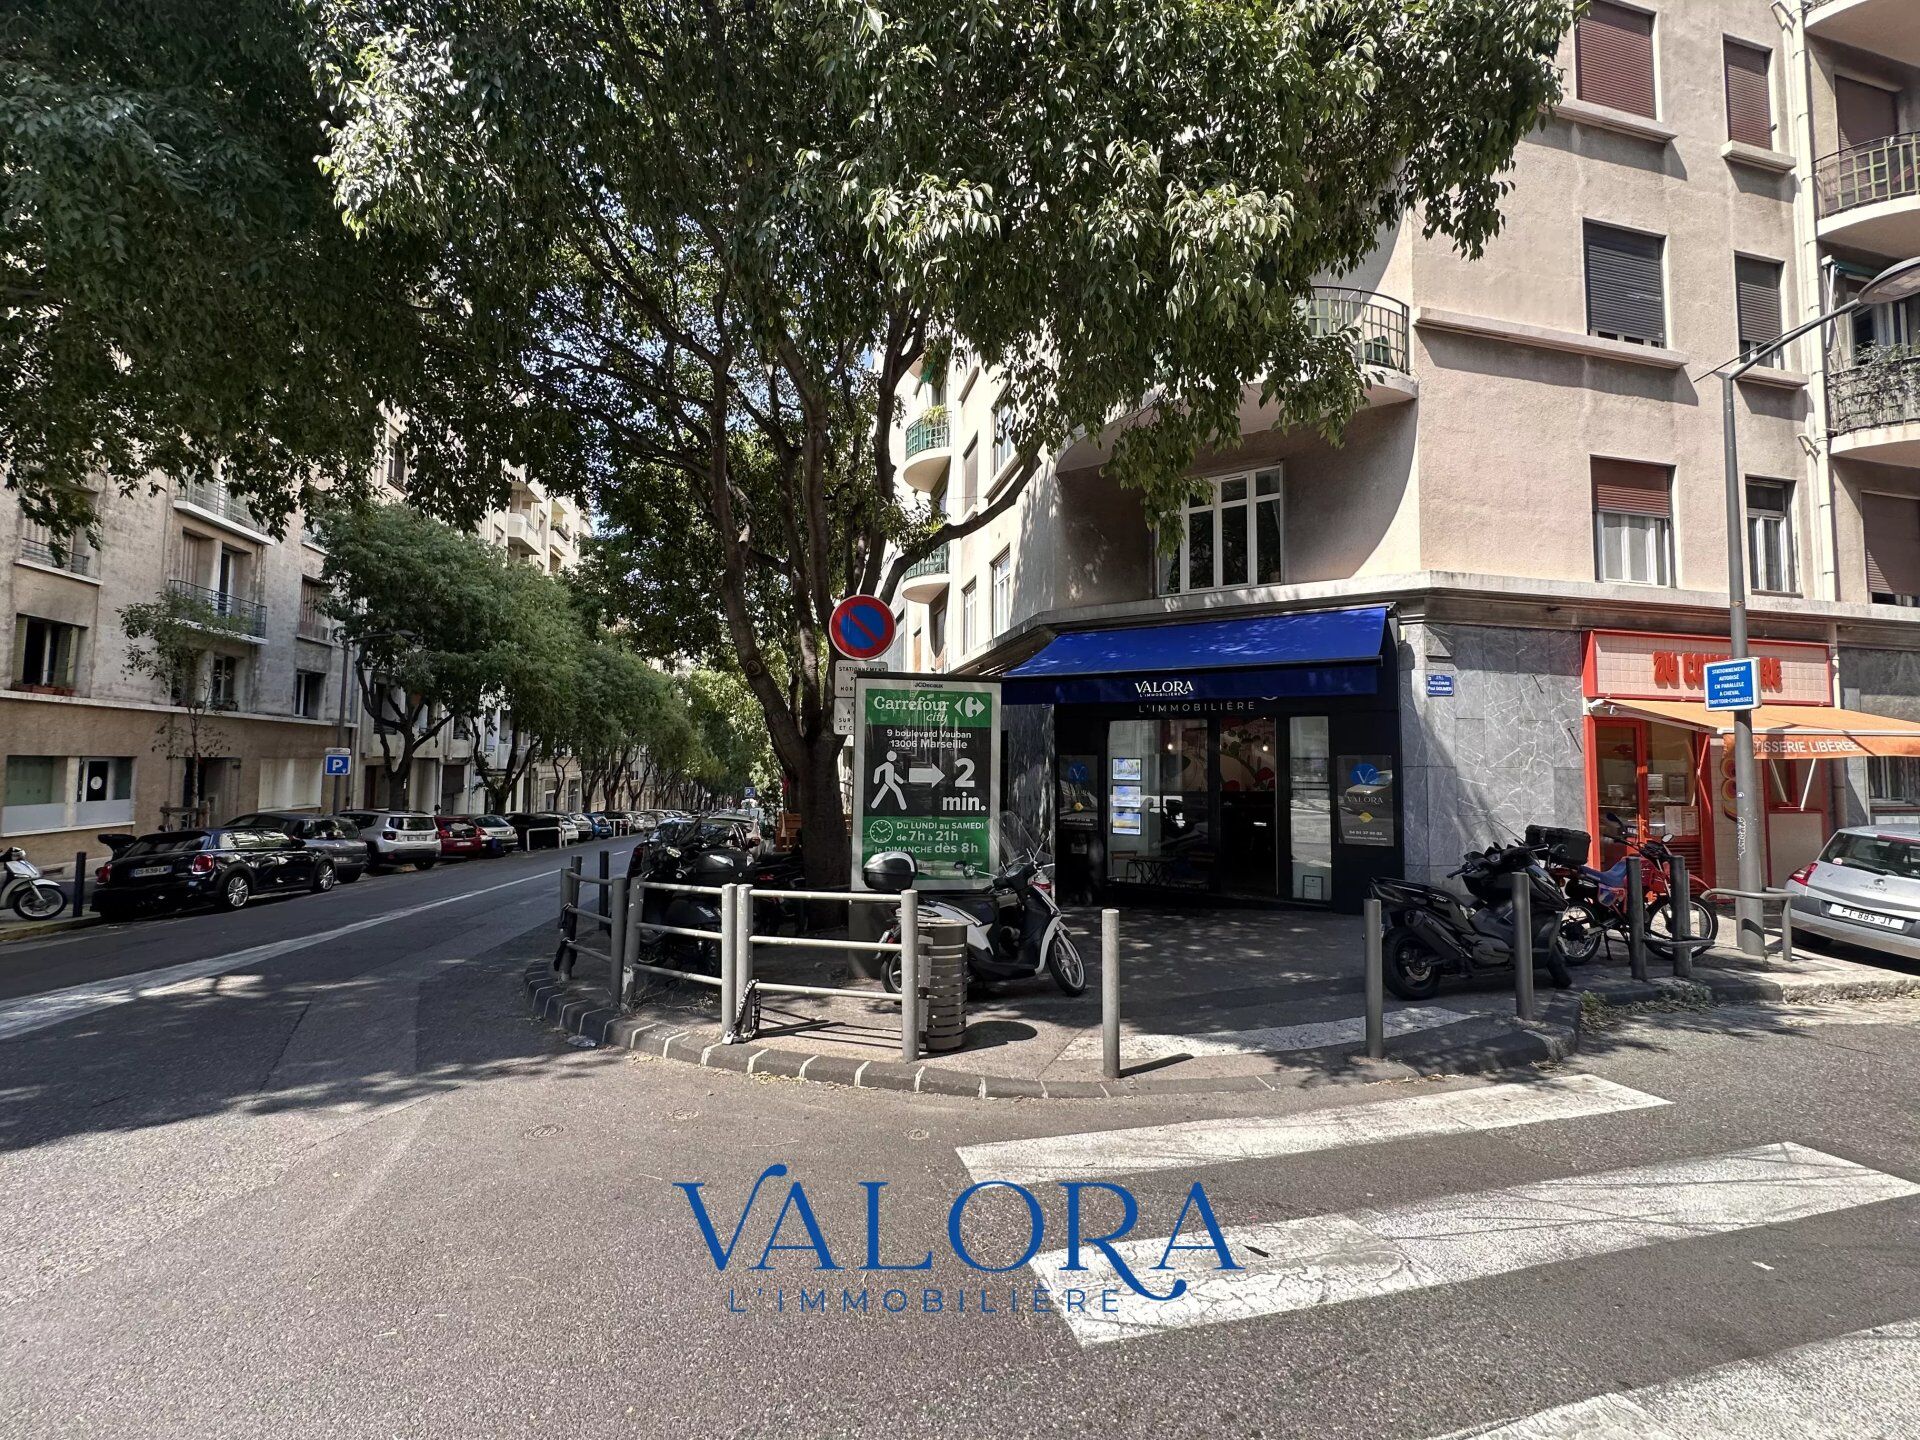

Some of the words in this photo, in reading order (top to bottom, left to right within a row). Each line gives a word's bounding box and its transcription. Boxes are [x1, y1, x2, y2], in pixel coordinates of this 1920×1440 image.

[1711, 666, 1746, 674] STATIONNEMENT
[1135, 681, 1194, 695] VALORA
[874, 696, 949, 711] Carrefour
[1138, 700, 1254, 713] L'IMMOBILIÈRE
[926, 712, 948, 725] city
[887, 729, 892, 737] 9
[895, 729, 938, 738] boulevard
[940, 730, 971, 739] Vauban
[890, 739, 917, 748] 13006
[920, 739, 967, 749] Marseille
[1754, 741, 1808, 753] TISSERIE
[1809, 739, 1861, 753] LIBÉRÉE
[332, 759, 343, 771] P
[954, 758, 975, 788] 2
[942, 791, 987, 811] min.
[1347, 796, 1383, 805] VALORA
[911, 822, 937, 830] LUNDI
[951, 822, 984, 830] SAMEDI
[908, 831, 925, 841] 7h
[936, 831, 959, 841] 21h
[885, 846, 932, 854] DIMANCHE
[935, 843, 957, 853] dès
[961, 843, 978, 853] 8h
